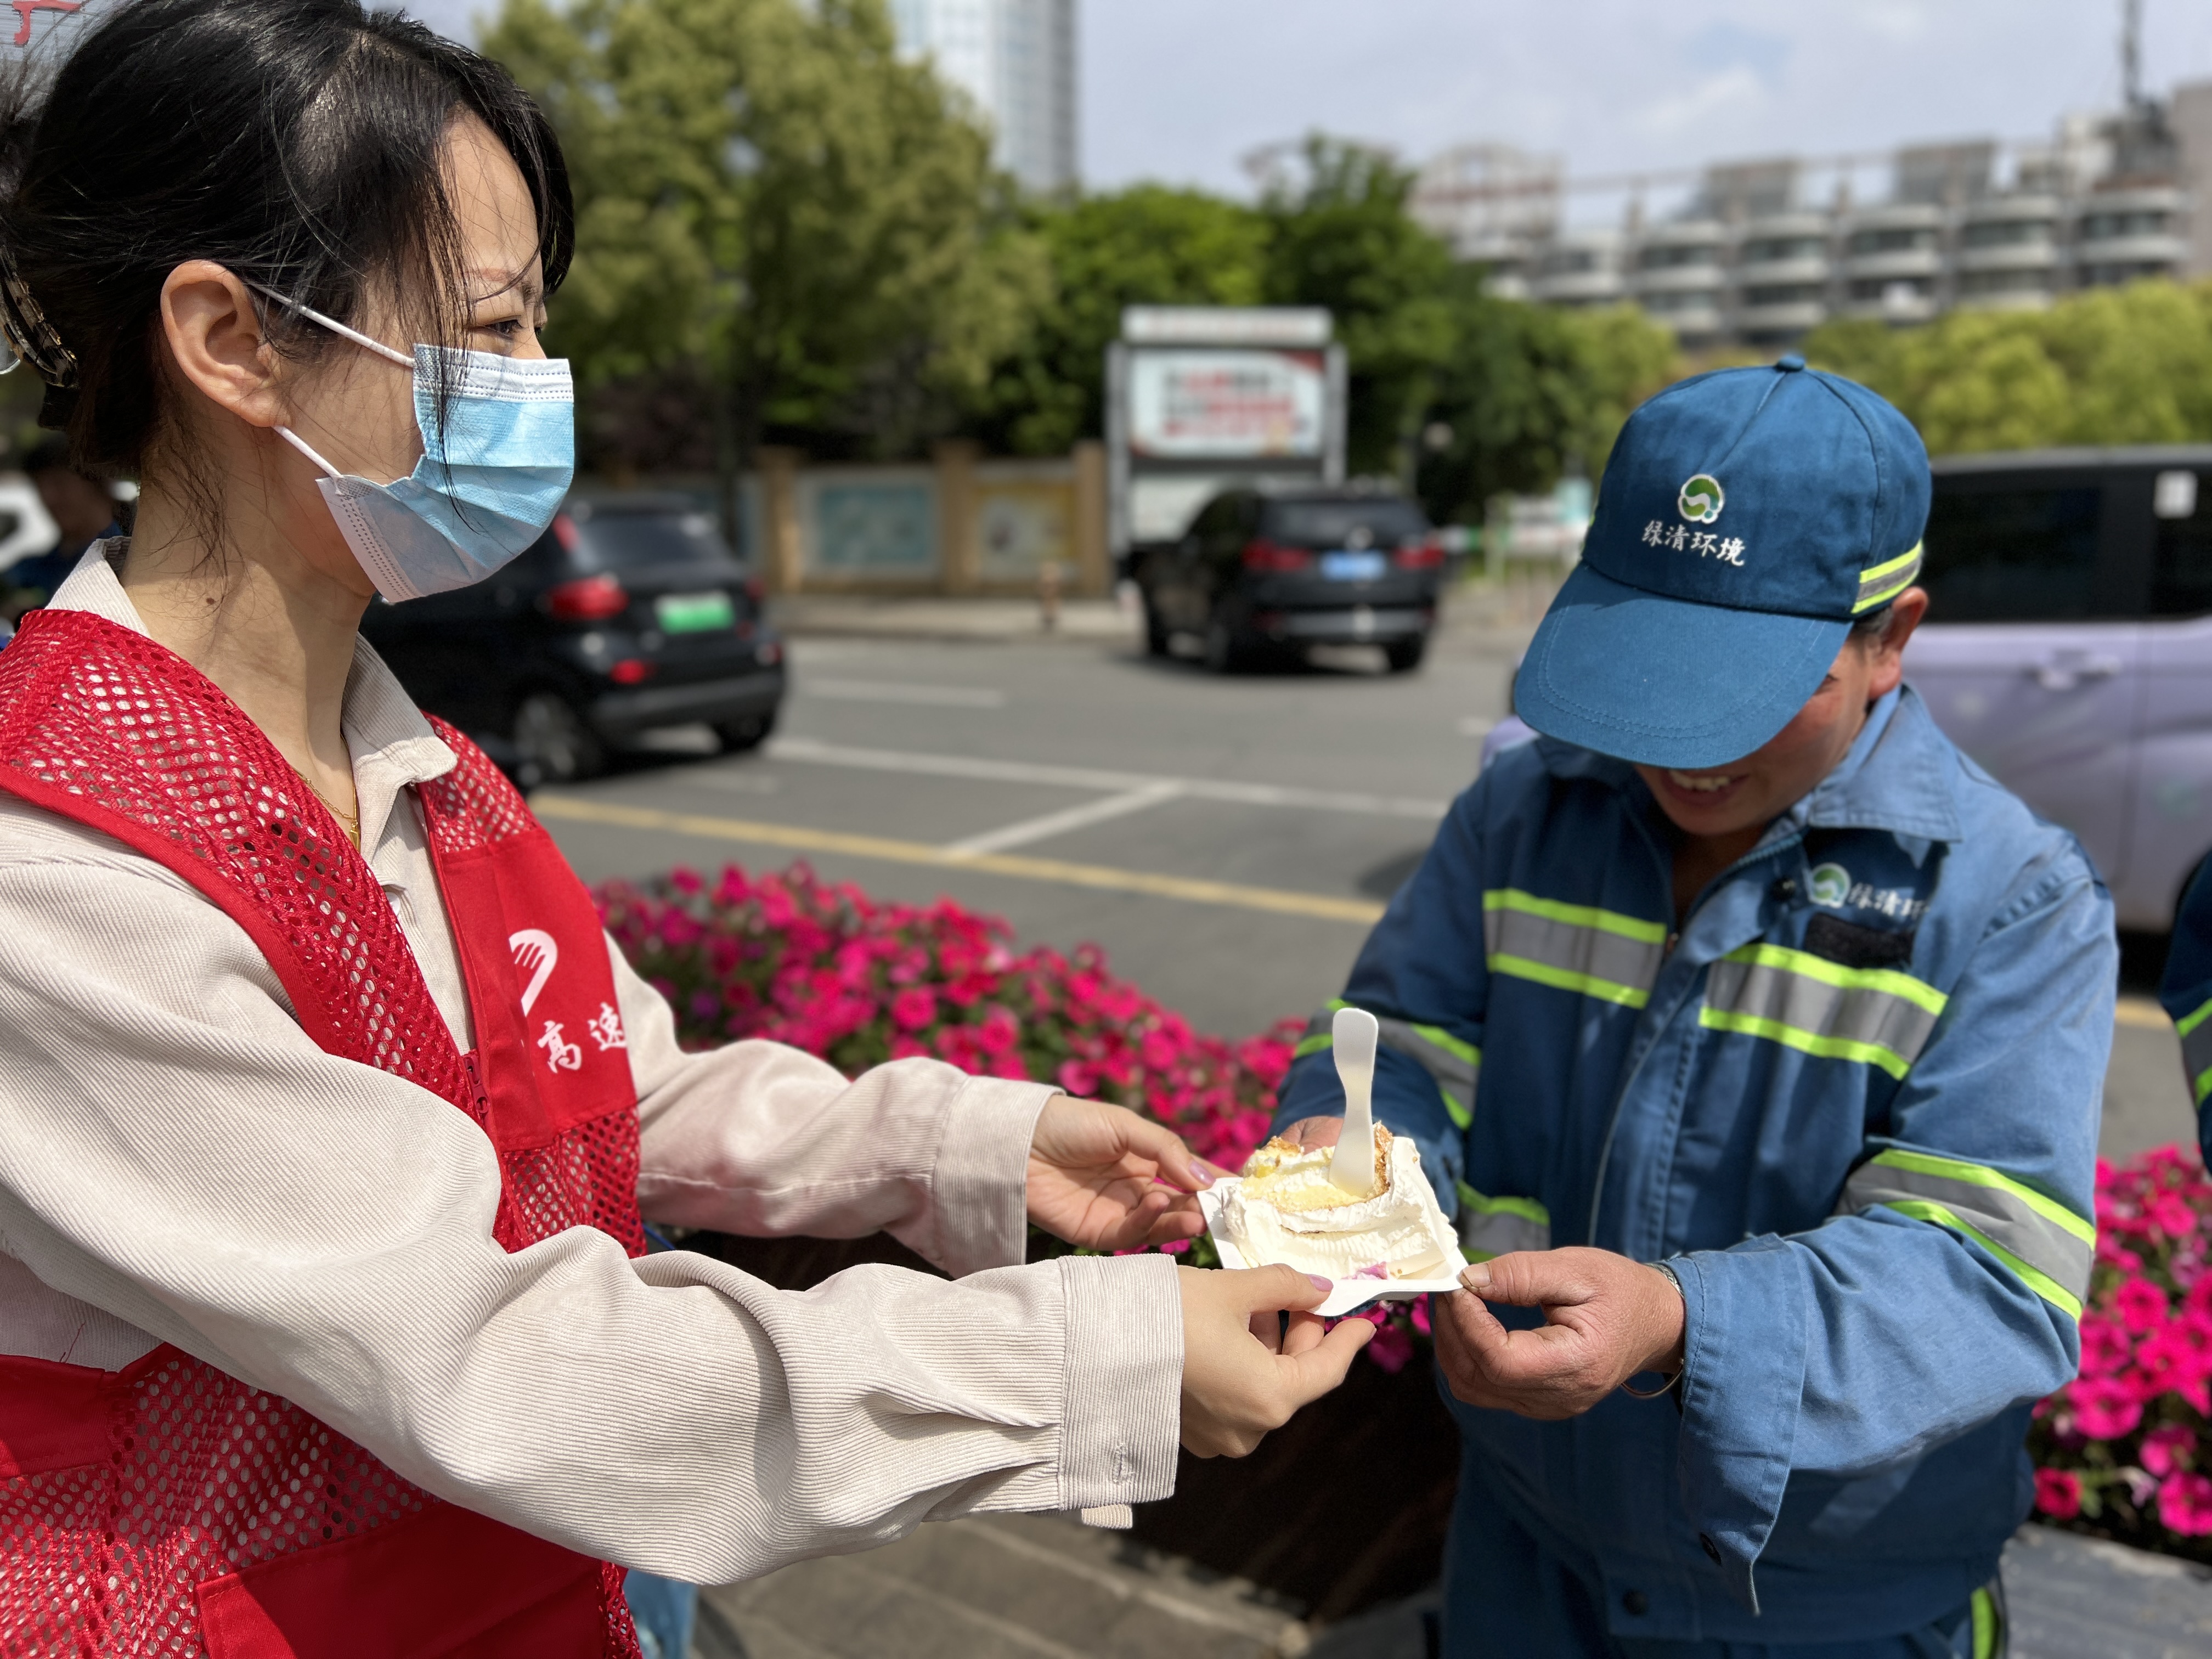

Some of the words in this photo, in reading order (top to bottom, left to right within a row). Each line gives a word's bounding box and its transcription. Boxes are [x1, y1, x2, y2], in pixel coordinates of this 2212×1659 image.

[1642, 520, 1746, 566] 绿清环境
[537, 1002, 627, 1074] 高速
